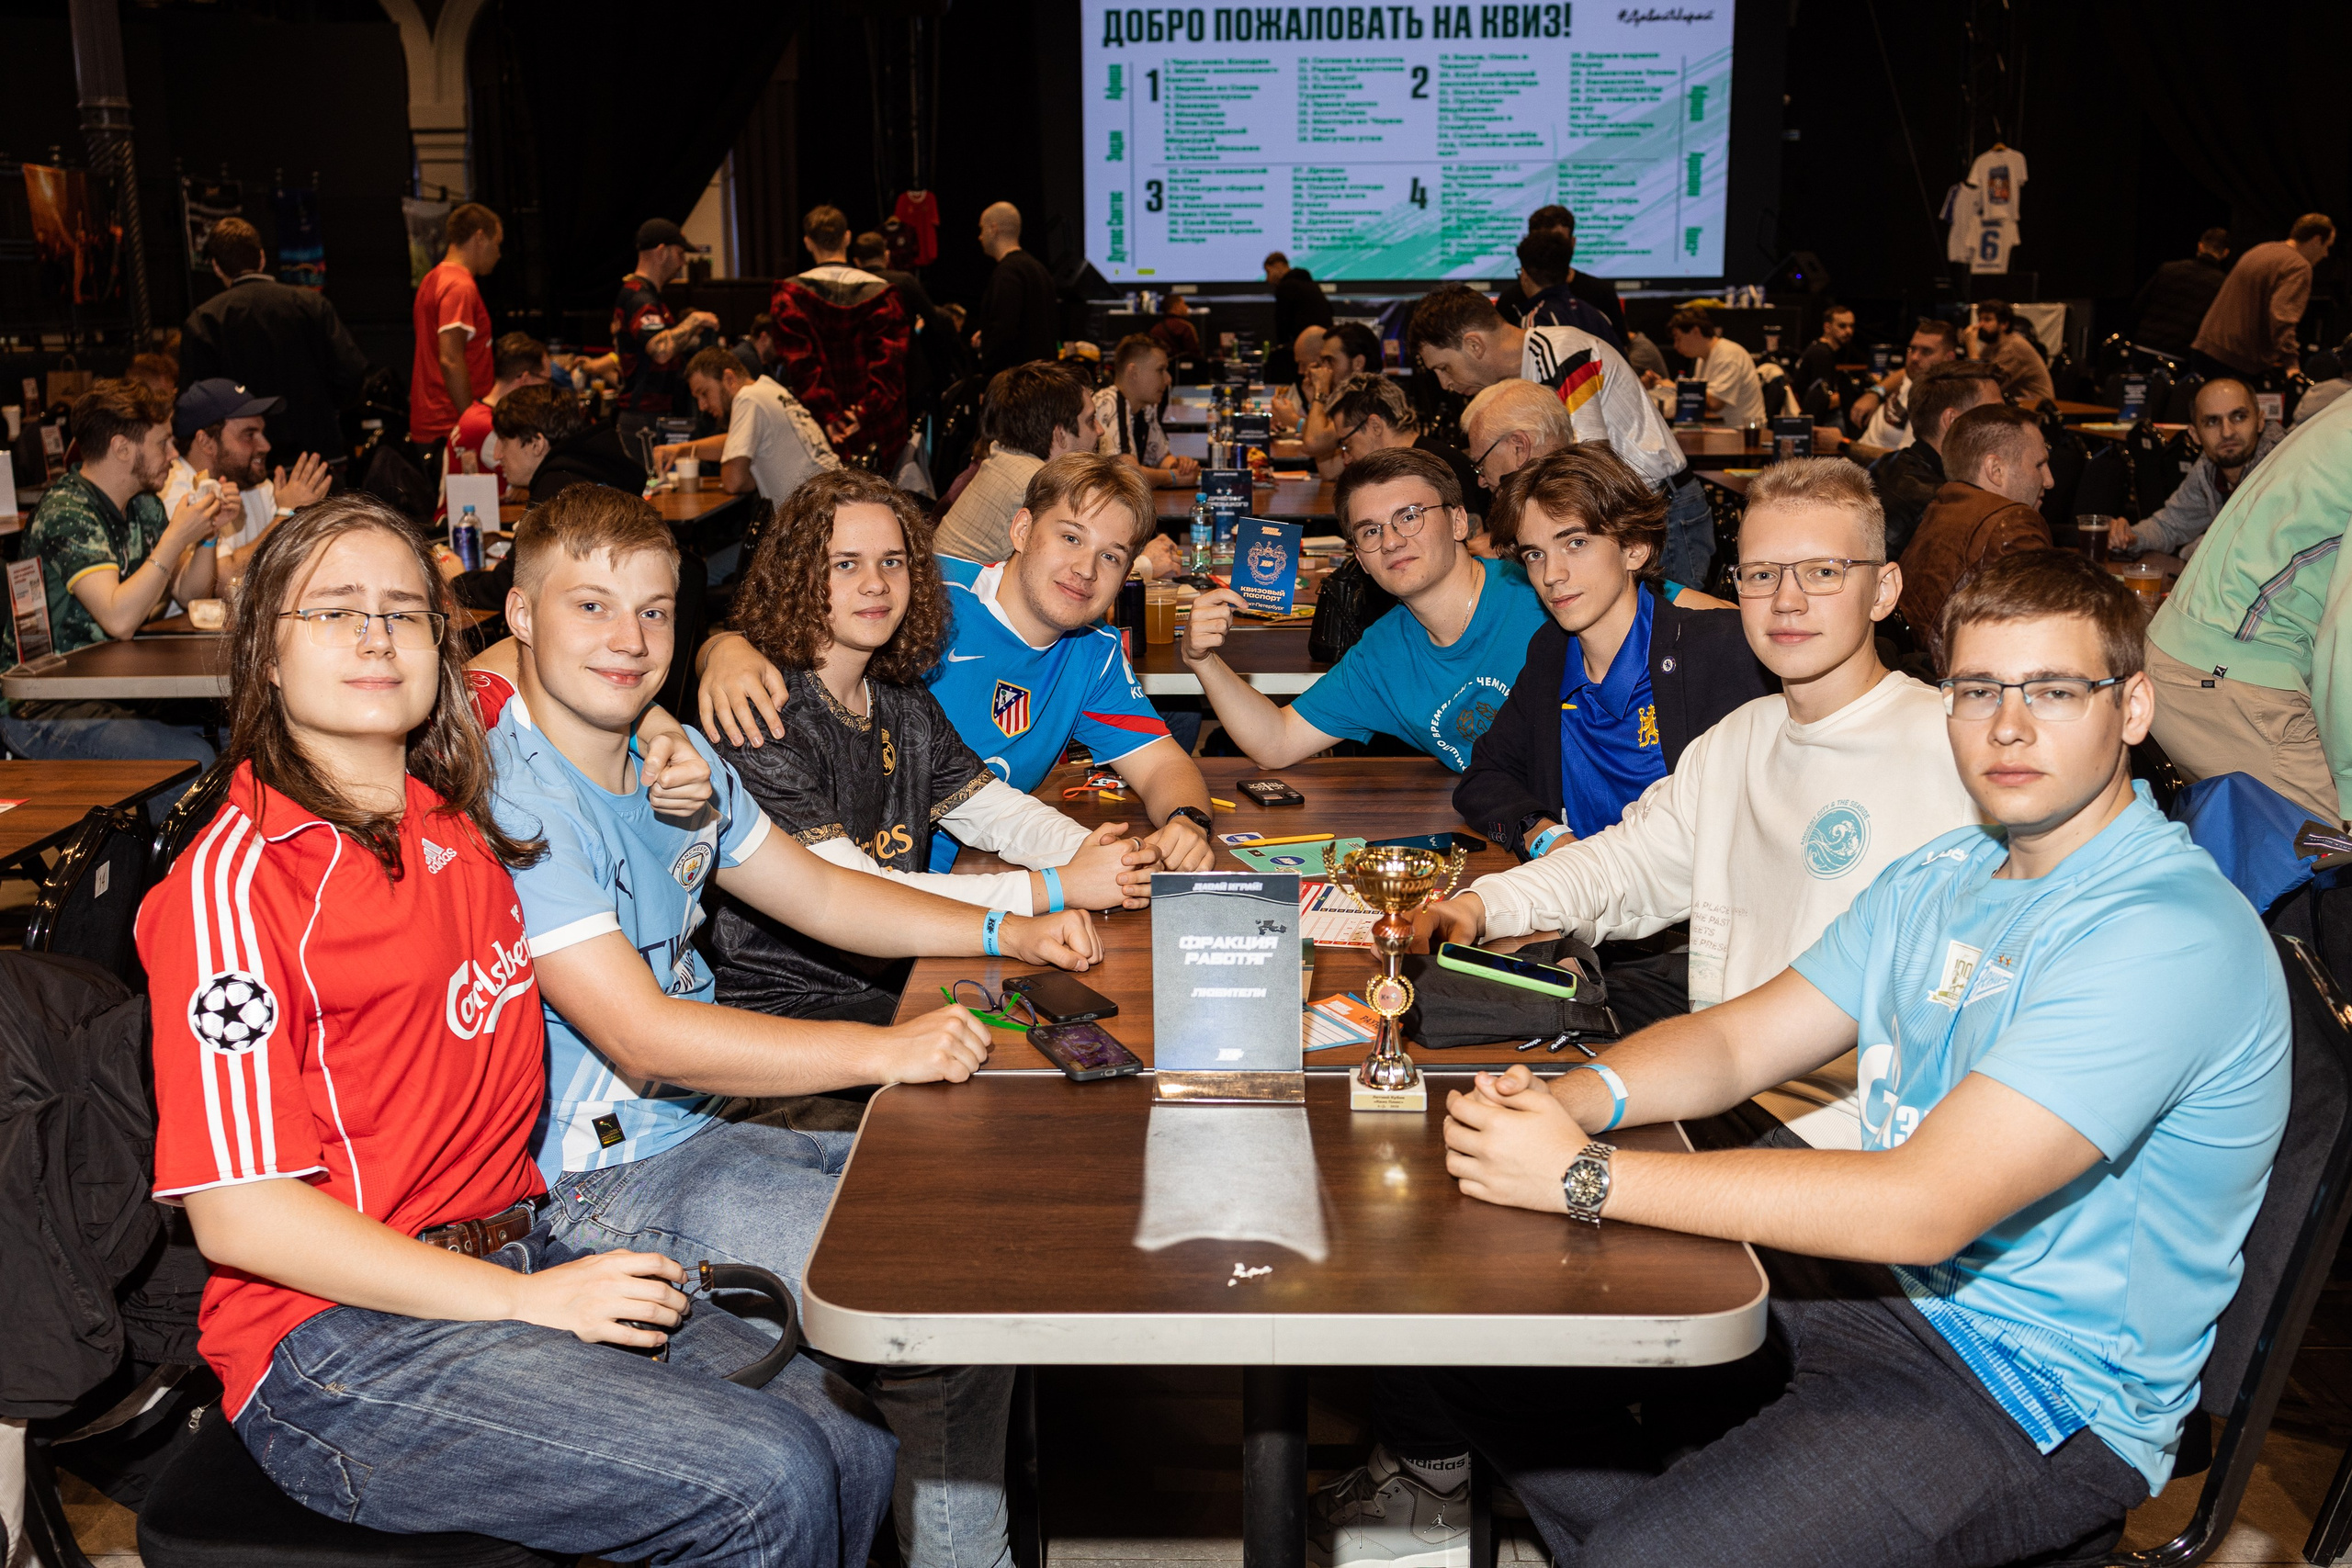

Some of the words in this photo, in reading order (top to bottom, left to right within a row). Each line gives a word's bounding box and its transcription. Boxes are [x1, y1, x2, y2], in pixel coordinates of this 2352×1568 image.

[1103, 8, 1205, 47] ДОБРО
[1215, 6, 1423, 41] ПОЖАЛОВАТЬ
[1433, 5, 1473, 39] НА
[1480, 3, 1571, 38] КВИЗ!
[1146, 69, 1159, 102] 1
[1410, 66, 1429, 99] 2
[1146, 180, 1163, 212] 3
[1409, 177, 1428, 209] 4
[1981, 230, 1999, 261] 6
[1476, 676, 1510, 697] ЧЕМПИ
[1801, 817, 1816, 845] ANCIENT
[1816, 804, 1830, 818] CITY
[1849, 800, 1871, 820] SEASIDE
[428, 847, 458, 874] adidas
[677, 846, 710, 869] MANCHESTER
[1690, 925, 1715, 936] EETS
[1692, 911, 1707, 922] THE
[1709, 915, 1730, 927] PAST
[1179, 934, 1279, 951] ФРАКЦИЯ
[1184, 952, 1273, 965] РАБОТЯГ
[1191, 987, 1268, 998] ЛЮБИТЕЛИ
[1408, 1458, 1465, 1471] didas
